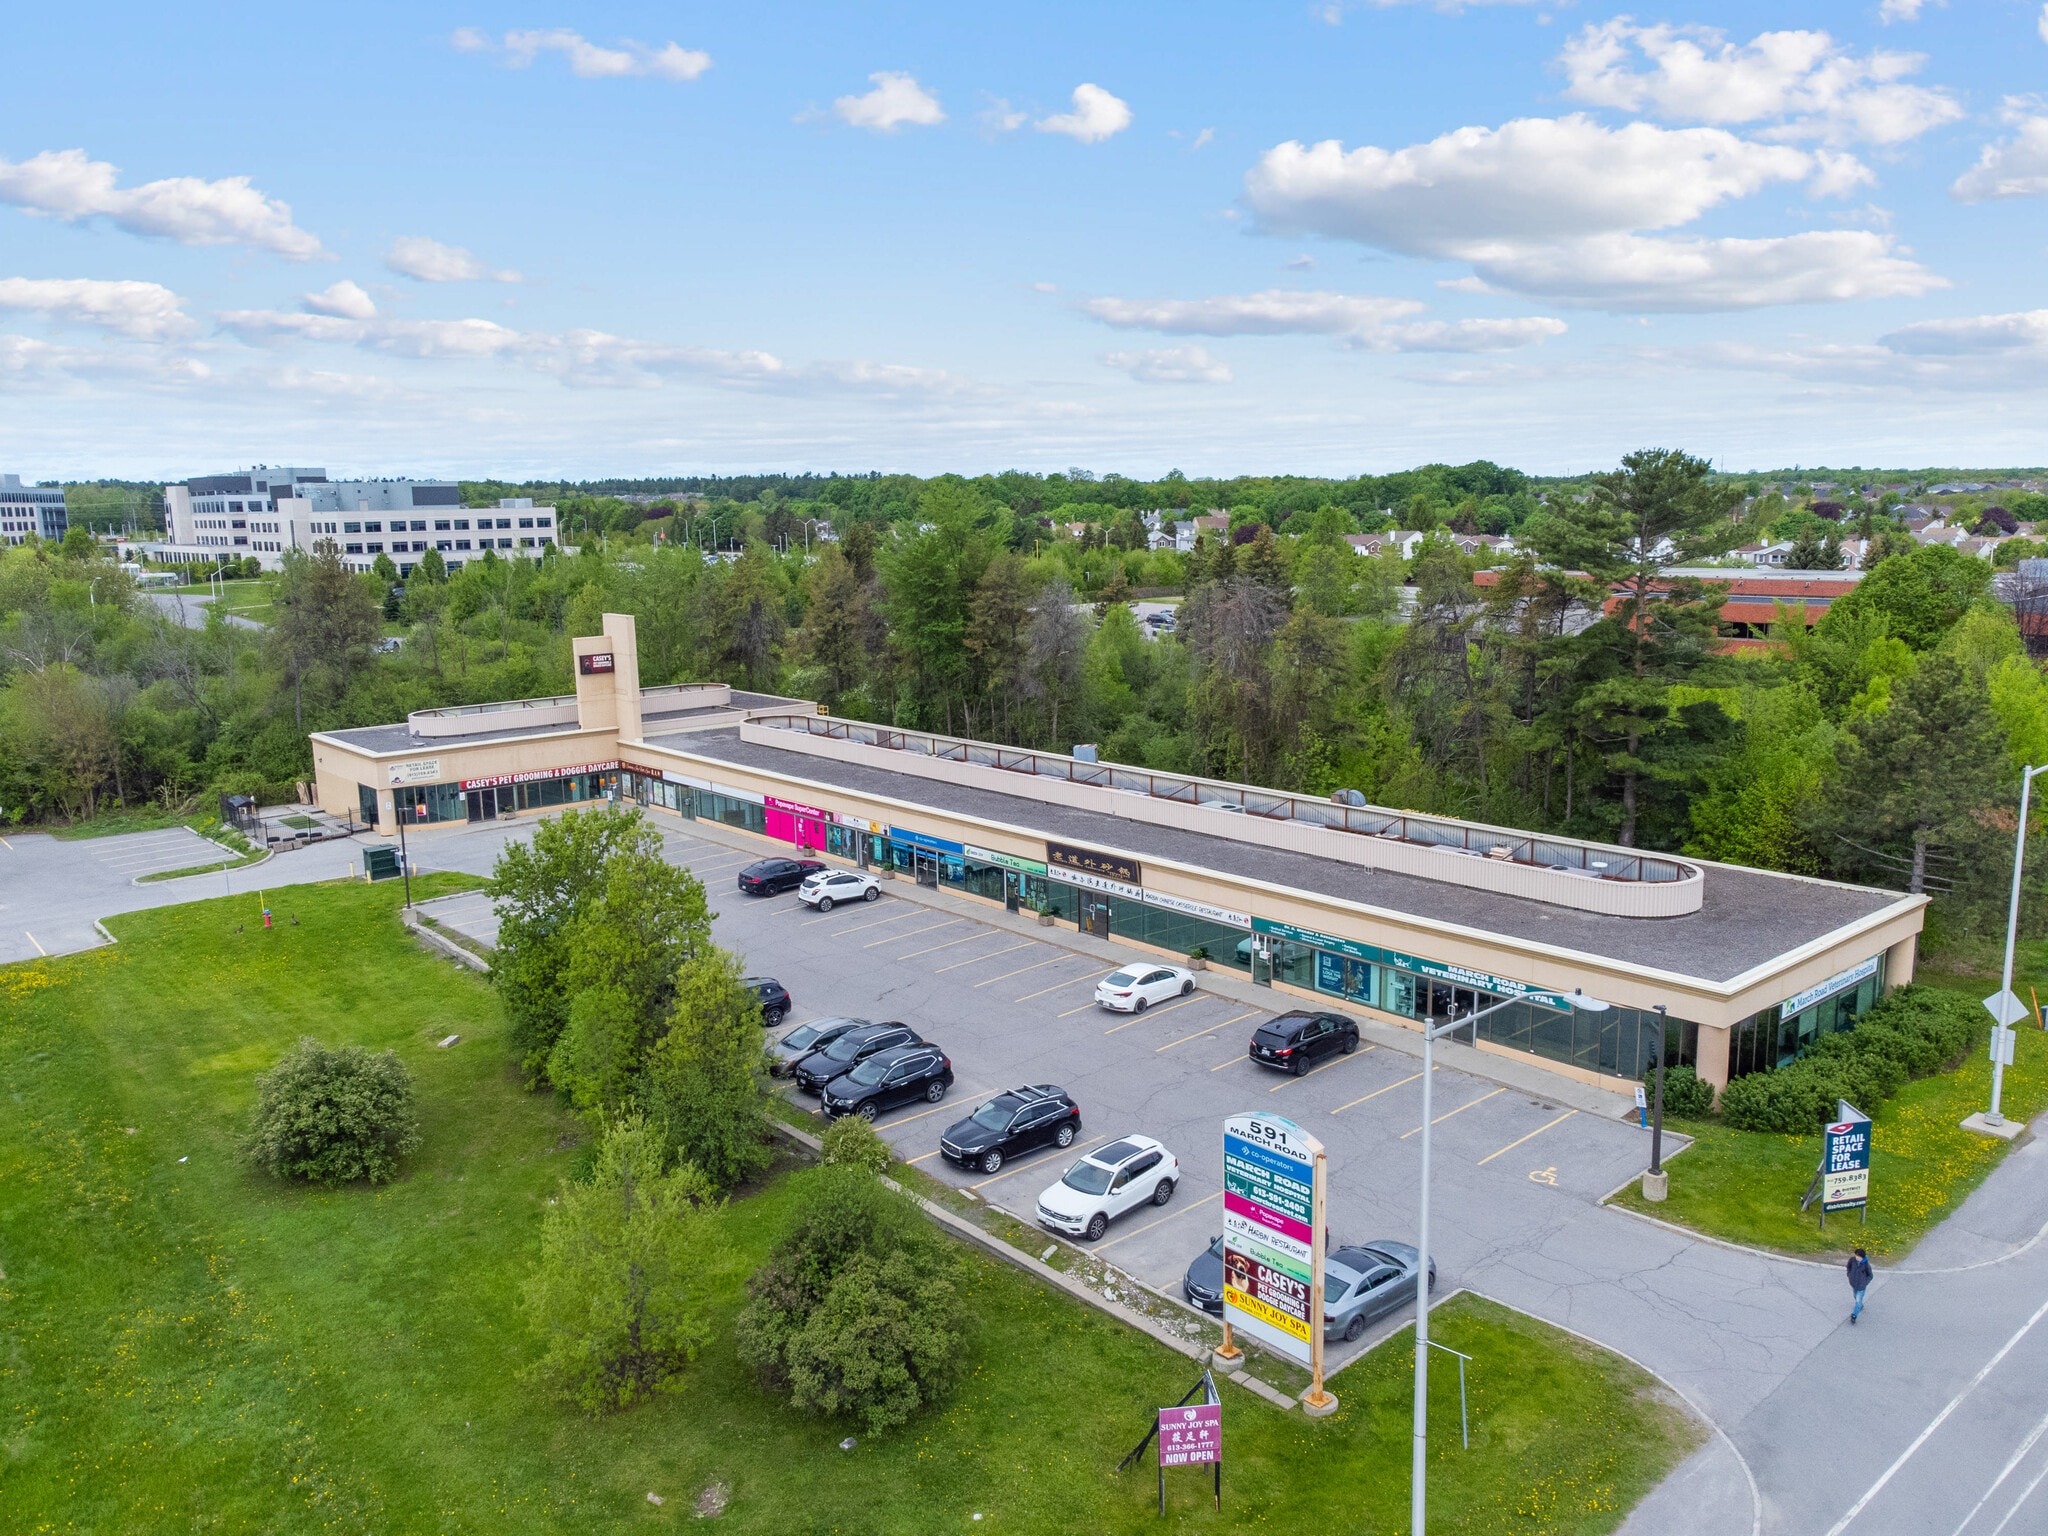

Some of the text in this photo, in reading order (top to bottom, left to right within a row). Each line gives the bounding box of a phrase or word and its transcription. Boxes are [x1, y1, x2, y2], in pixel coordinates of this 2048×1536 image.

[592, 654, 612, 662] CASEY'S
[466, 776, 498, 790] CASEY'S
[498, 775, 513, 785] PET
[513, 769, 553, 783] GROOMING
[554, 769, 560, 777] &
[561, 764, 587, 777] DOGGIE
[588, 760, 619, 773] DAYCARE
[991, 854, 1020, 867] Bubble Tea
[1421, 965, 1494, 990] VETERINARY
[1448, 965, 1527, 991] MARCH ROAD
[1796, 962, 1875, 1008] March Road Veterinary Hospital
[1230, 1126, 1307, 1161] MARCH ROAD
[1250, 1121, 1287, 1145] 591
[1832, 1133, 1866, 1146] RETAIL
[1831, 1142, 1864, 1154] SPACE
[1831, 1153, 1851, 1163] FOR
[1251, 1151, 1294, 1172] co-operators
[1831, 1160, 1861, 1172] LEASE
[1226, 1155, 1311, 1195] MARCH ROAD
[1226, 1164, 1311, 1204] VETERINARY HOSPITAL
[1250, 1194, 1309, 1223] marchroadvet.com
[1253, 1186, 1306, 1214] 613-591-2408
[1248, 1225, 1309, 1258] HARBIN RESTAURANT
[1250, 1248, 1284, 1268] Bubble Tea
[1257, 1265, 1306, 1300] CASEY'S
[1257, 1282, 1305, 1313] PET GROOMING &
[1257, 1290, 1306, 1321] DOGGIE DAYCARE
[1239, 1294, 1269, 1315] SUNNY
[1270, 1309, 1288, 1324] JOY
[1289, 1318, 1307, 1335] SPA
[1160, 1419, 1219, 1431] SUNNY JOY SPA
[1165, 1450, 1214, 1464] NOW OPEN
[1167, 1441, 1214, 1451] 613-366-1777
